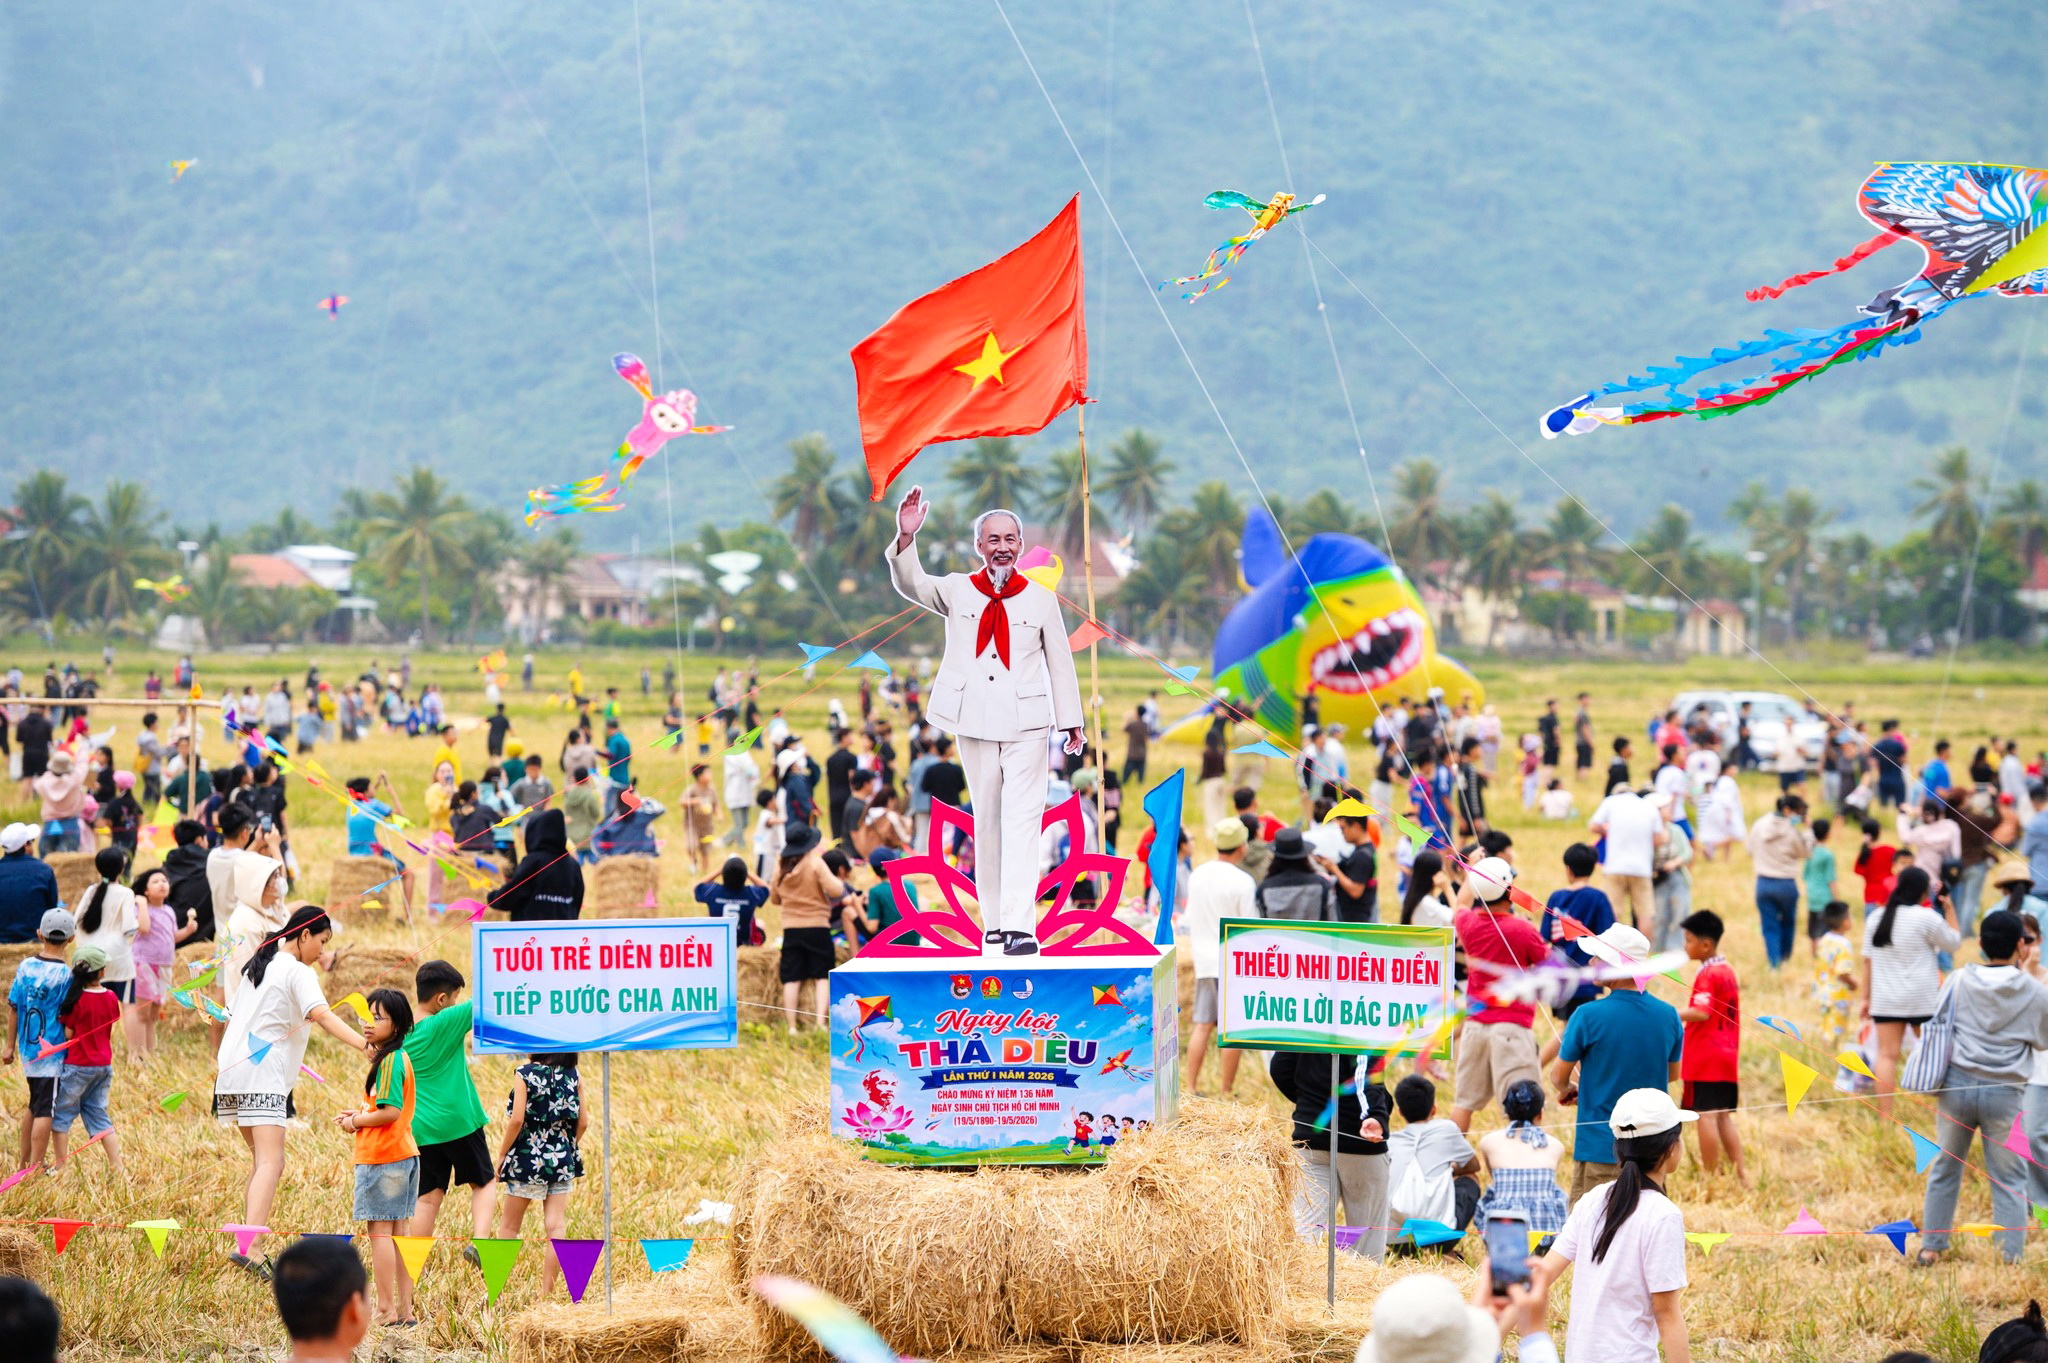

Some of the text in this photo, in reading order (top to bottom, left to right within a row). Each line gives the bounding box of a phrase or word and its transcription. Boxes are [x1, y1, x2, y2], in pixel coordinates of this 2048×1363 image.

[493, 935, 713, 972] TUỔI TRẺ DIÊN ĐIỀN
[1232, 944, 1439, 985] THIẾU NHI DIÊN ĐIỀN
[493, 982, 718, 1015] TIẾP BƯỚC CHA ANH
[1243, 990, 1297, 1022] VÂNG
[1303, 992, 1333, 1024] LỜI
[1340, 995, 1381, 1027] BÁC
[935, 1008, 1058, 1035] Ngày hội
[898, 1033, 1098, 1066] THẢ DIỀU
[943, 1069, 1054, 1082] LẦN THỨ I NĂM 2026
[931, 1100, 1060, 1114] NGÀY SINH CHỦ TỊCH HỒ CHÍ MINH
[937, 1088, 958, 1099] CHÀO
[960, 1087, 983, 1099] MỪNG
[997, 1088, 1017, 1100] NIỆM
[1019, 1089, 1033, 1098] 136
[1035, 1088, 1054, 1098] NĂM
[953, 1115, 1038, 1126] (19/5/1890-19/5/2026)
